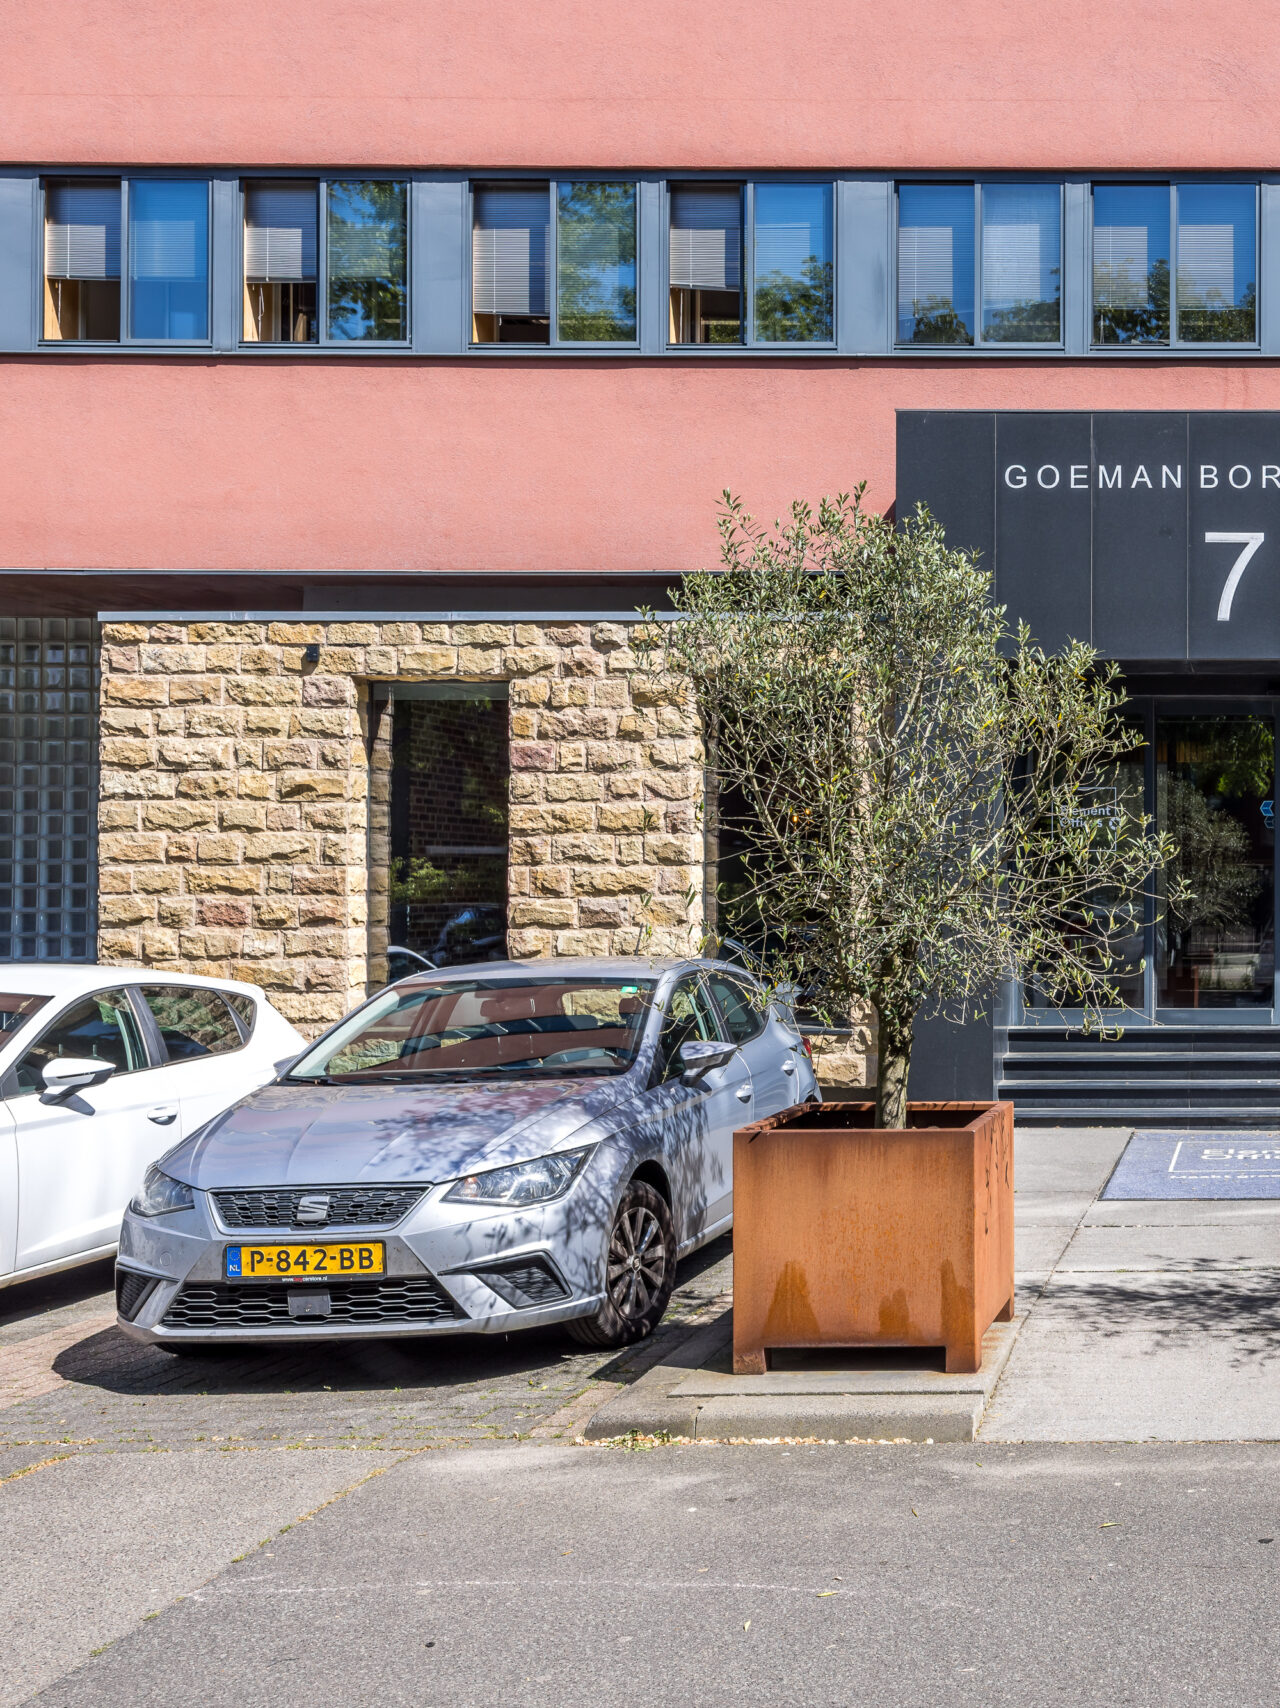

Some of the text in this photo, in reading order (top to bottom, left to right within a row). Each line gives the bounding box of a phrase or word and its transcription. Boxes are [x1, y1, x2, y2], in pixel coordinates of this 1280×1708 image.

[1004, 464, 1182, 489] GOEMAN
[229, 1247, 374, 1273] NL P-842-BB
